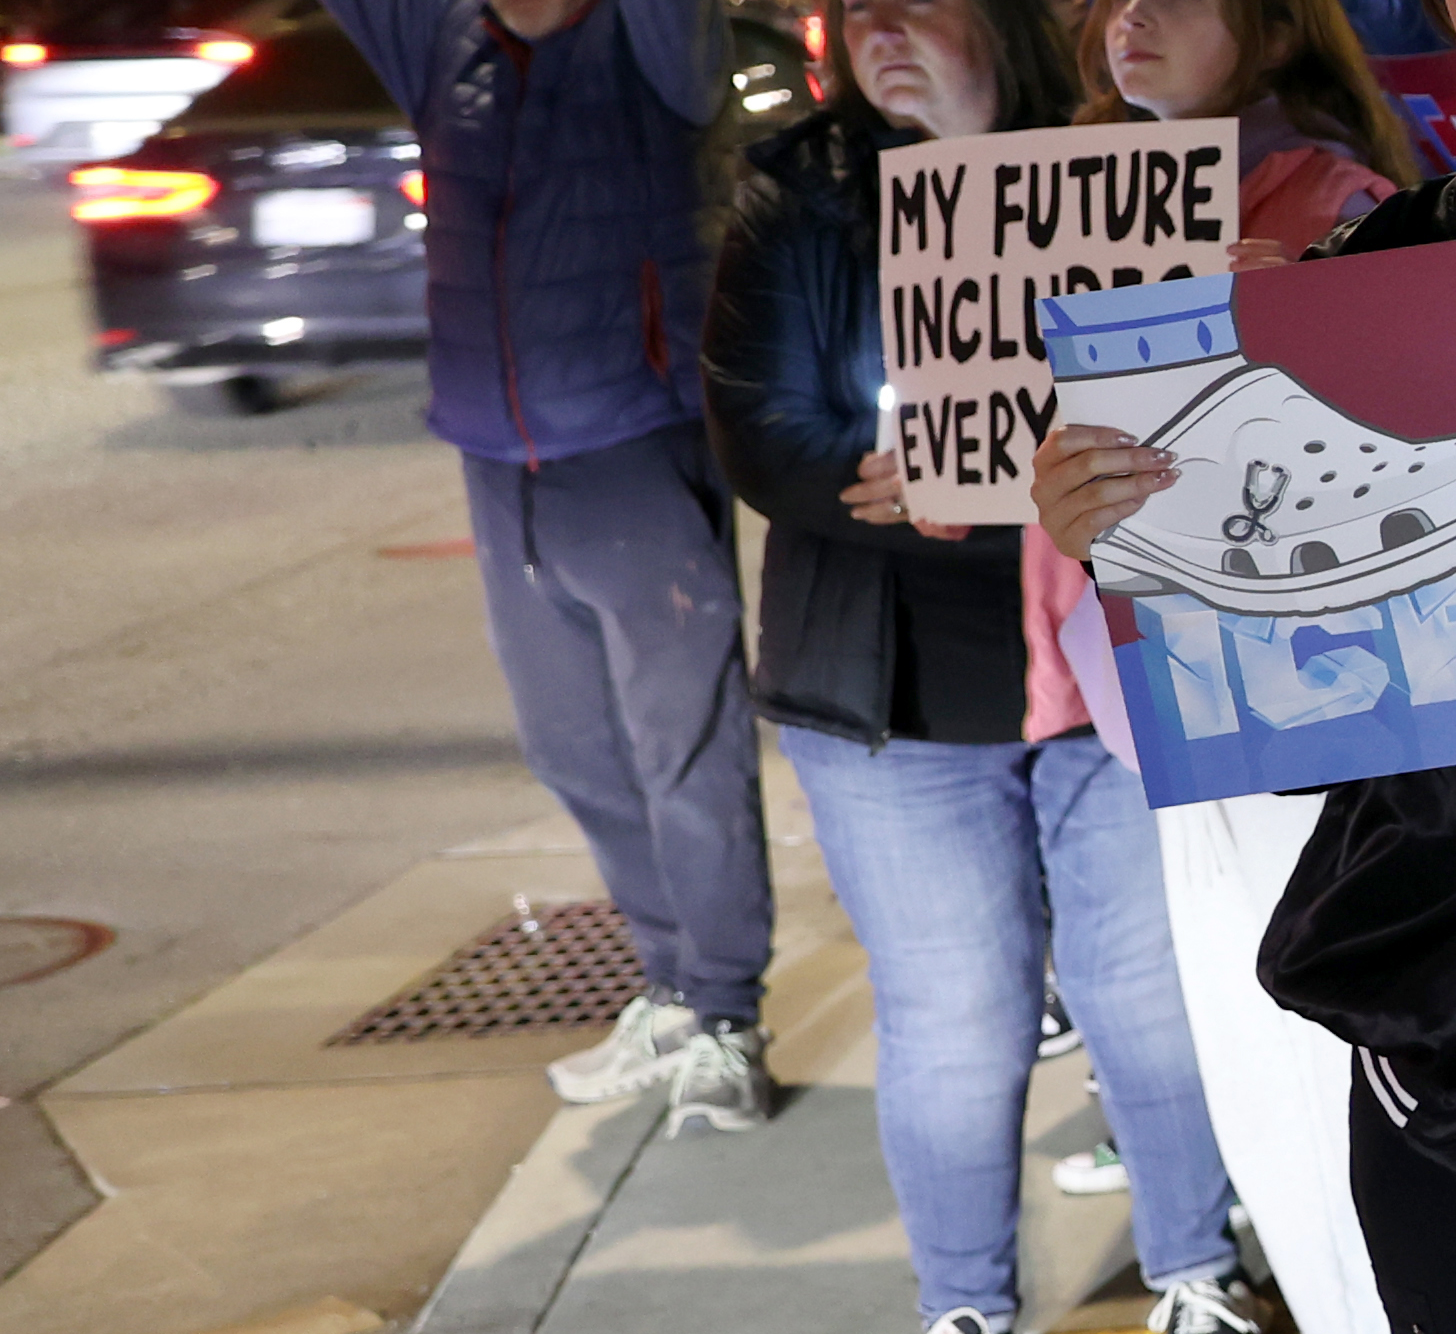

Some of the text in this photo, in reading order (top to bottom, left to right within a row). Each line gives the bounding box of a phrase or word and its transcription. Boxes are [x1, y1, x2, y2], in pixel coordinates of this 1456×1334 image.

[890, 145, 1223, 260] MY FUTURE
[893, 263, 1197, 371] INCLU
[899, 385, 1060, 487] EVERY
